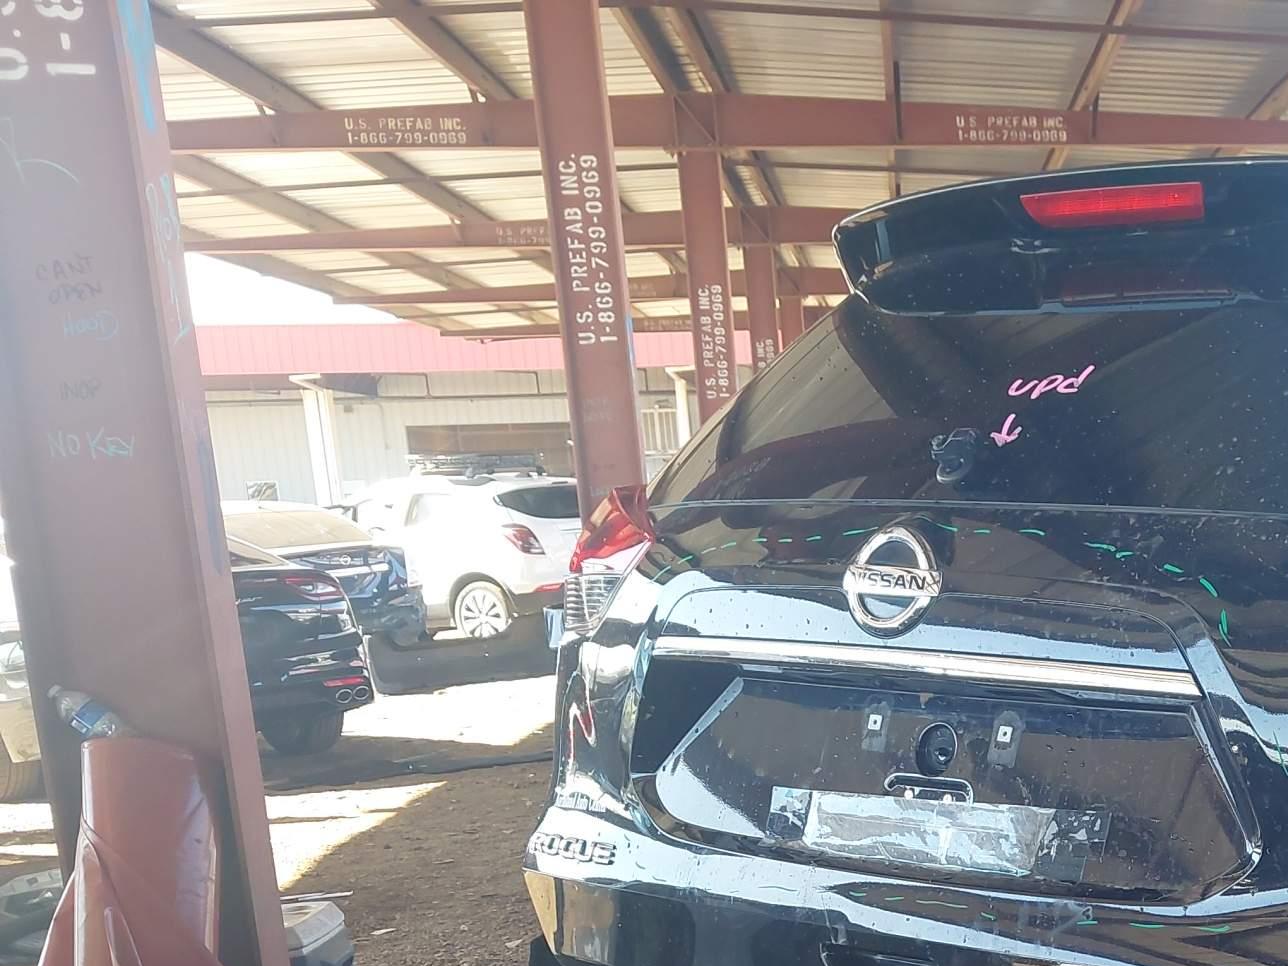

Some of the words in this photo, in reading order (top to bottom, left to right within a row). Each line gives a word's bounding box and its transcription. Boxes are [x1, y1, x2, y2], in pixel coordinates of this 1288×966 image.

[347, 131, 467, 145] 1-866-799-0969
[379, 117, 432, 131] PREFAB
[439, 117, 467, 131] INC.
[987, 116, 1037, 129] PREFAB
[558, 153, 581, 196] INC.
[564, 206, 591, 292] PREFAB
[579, 154, 619, 343] 1-866-799-0969
[576, 304, 597, 345] U.S.
[701, 316, 715, 367] PREFAB
[711, 284, 730, 397] 1-866-799-0969
[48, 426, 80, 457] NO
[528, 832, 616, 866] ROGUE
